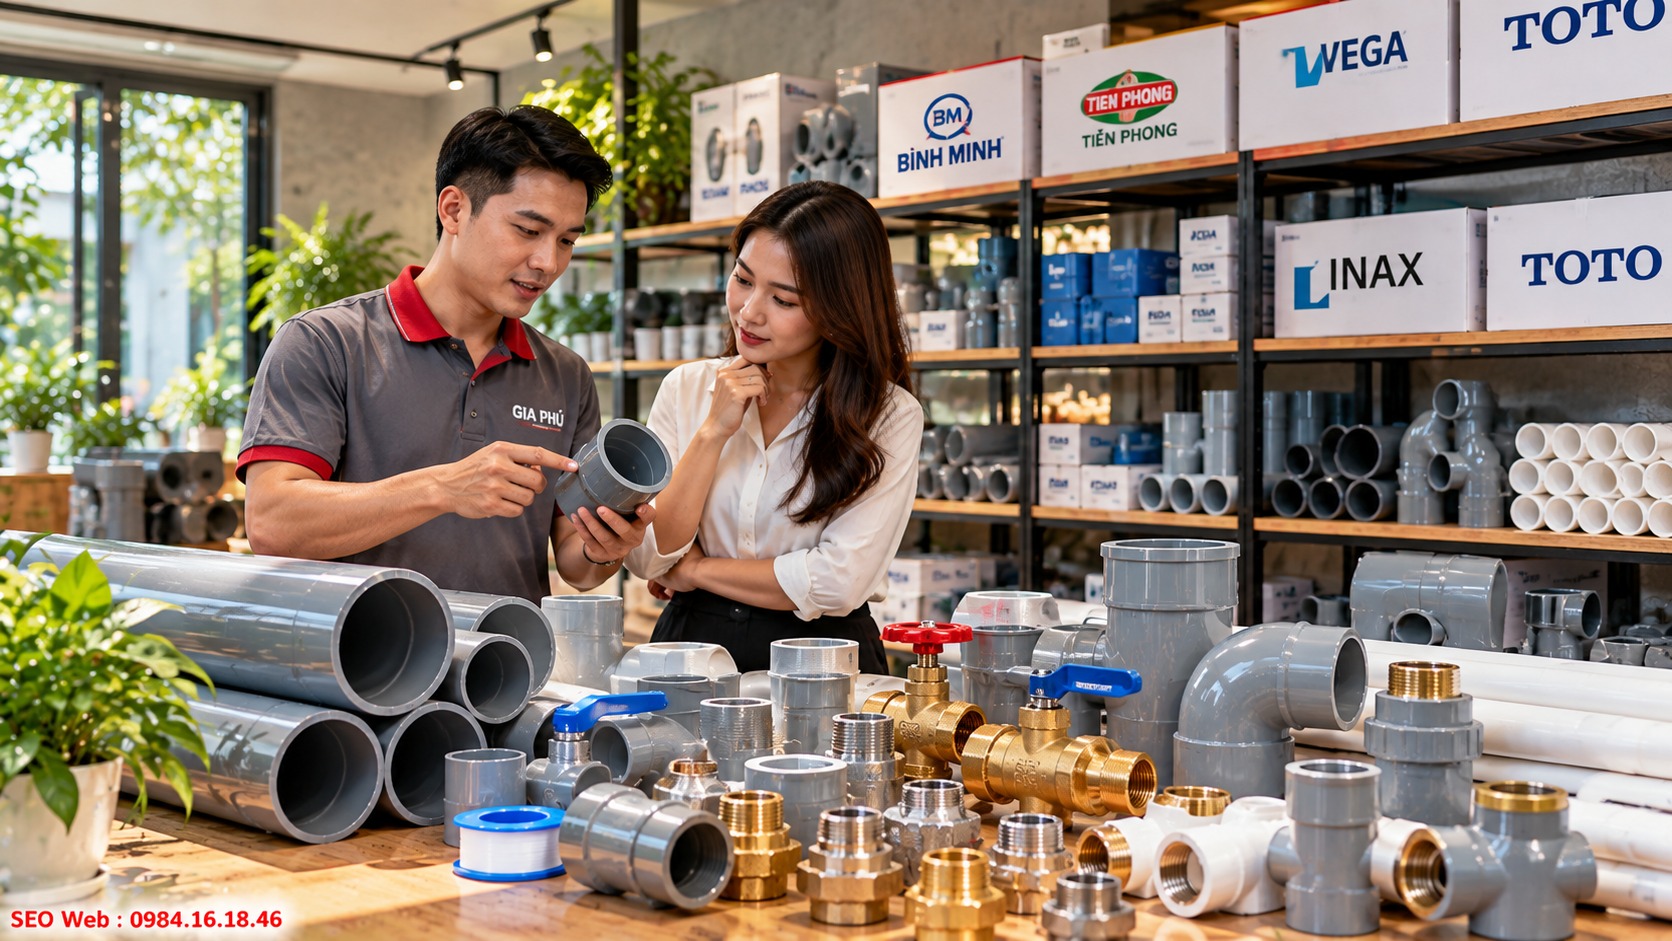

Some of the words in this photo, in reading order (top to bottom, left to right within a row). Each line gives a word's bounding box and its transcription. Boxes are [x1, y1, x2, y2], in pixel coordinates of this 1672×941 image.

[1504, 0, 1666, 51] TOTO
[1086, 93, 1118, 112] TIEN
[1121, 84, 1172, 108] PHONG
[933, 107, 962, 127] BM
[1121, 122, 1178, 144] PHONG
[949, 138, 1002, 165] MINH
[1330, 252, 1424, 291] INAX
[1521, 244, 1663, 287] TOTO
[512, 404, 537, 422] GIA
